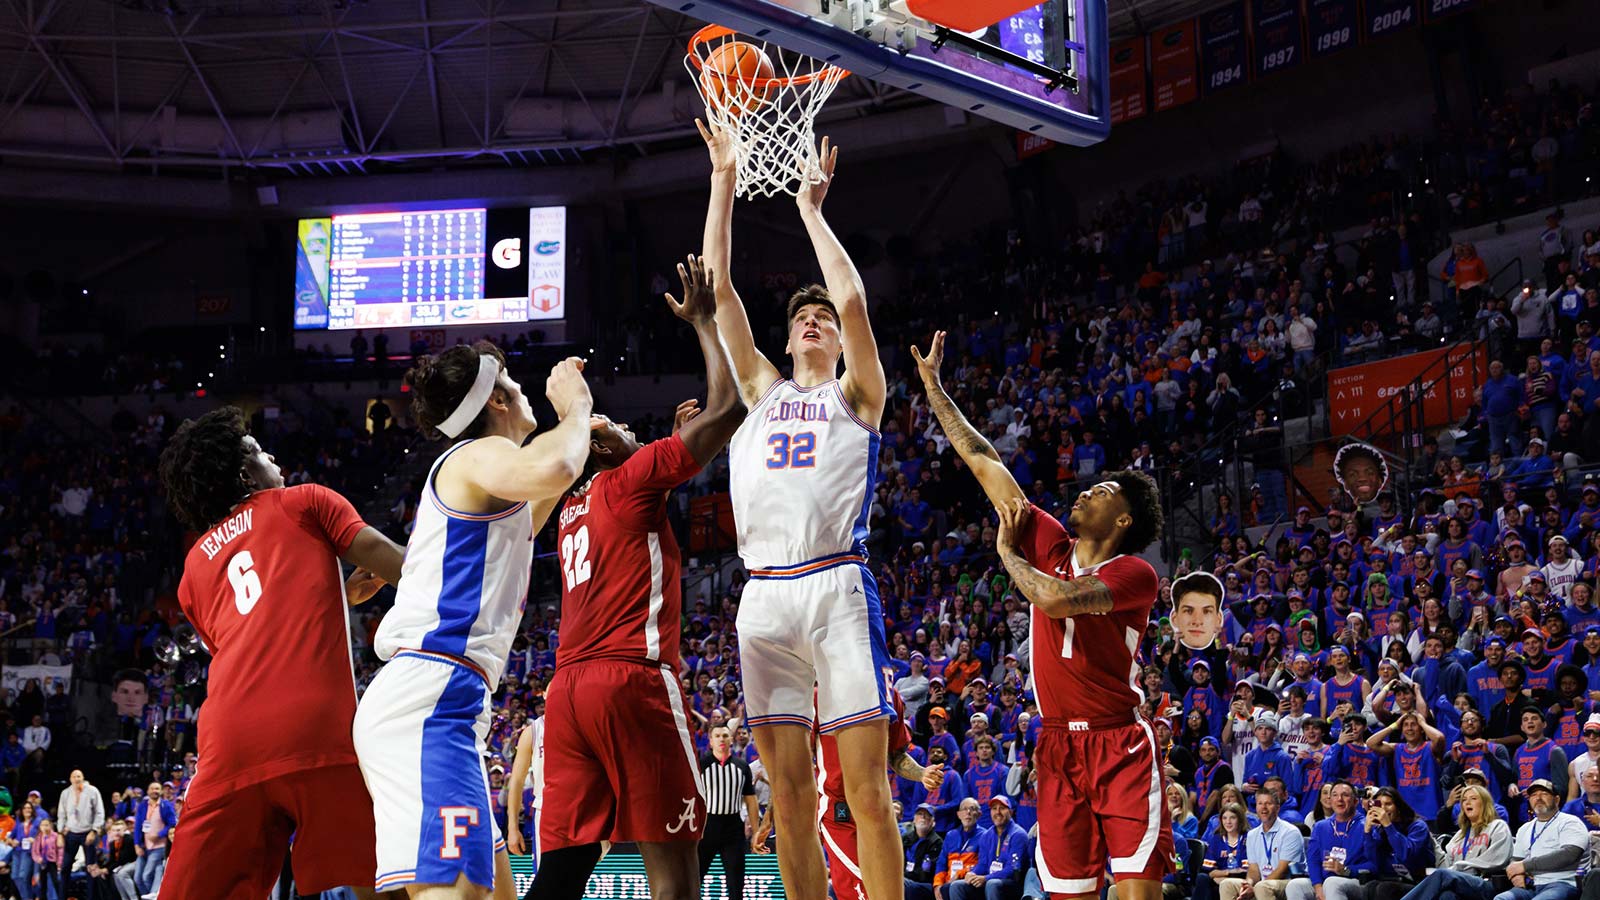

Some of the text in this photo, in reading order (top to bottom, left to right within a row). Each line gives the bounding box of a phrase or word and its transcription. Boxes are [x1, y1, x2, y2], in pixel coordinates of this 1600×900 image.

[1371, 7, 1411, 33] 2004
[1317, 26, 1351, 52] 1998
[1262, 46, 1294, 71] 1997
[1211, 64, 1241, 88] 1994
[492, 238, 520, 269] G
[199, 295, 232, 313] 207
[1333, 374, 1365, 386] SECTION
[1351, 386, 1363, 397] 111
[1454, 388, 1466, 399] 13
[765, 401, 829, 425] FLORIDA
[1352, 408, 1361, 417] 11
[766, 431, 816, 470] 32
[200, 508, 254, 560] JEMISON
[561, 525, 591, 593] 22
[227, 550, 263, 616] 6
[1068, 721, 1089, 731] RTR
[1241, 742, 1252, 755] 10
[1280, 733, 1309, 744] FLORID
[1288, 746, 1298, 761] 5
[1403, 763, 1421, 778] 26
[1519, 764, 1534, 779] 26
[666, 797, 698, 834] A
[438, 805, 478, 859] F
